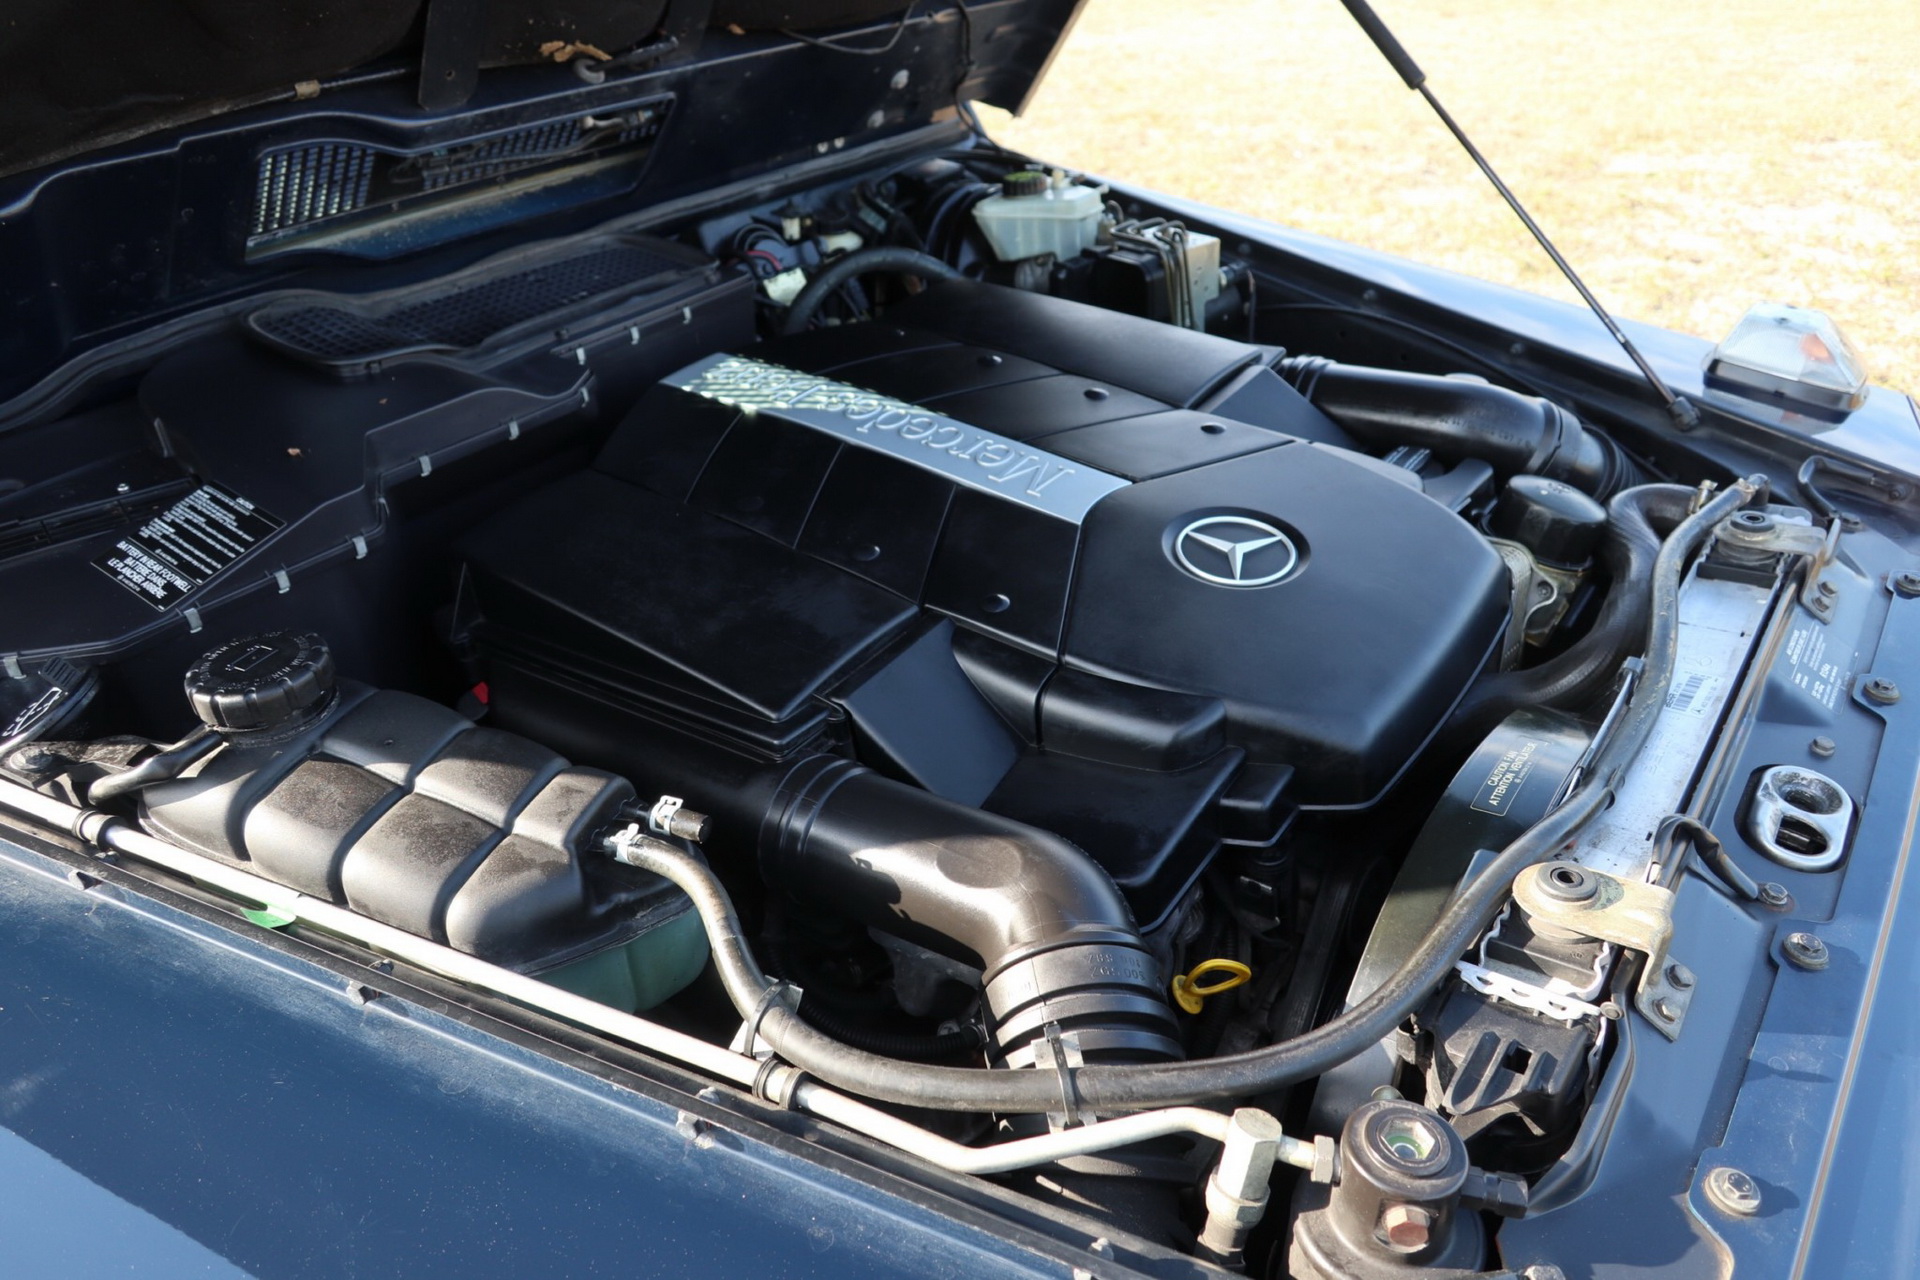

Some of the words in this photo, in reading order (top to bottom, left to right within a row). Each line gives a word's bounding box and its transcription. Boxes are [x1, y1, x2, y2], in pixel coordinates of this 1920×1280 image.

[115, 540, 143, 560] BATTERY
[139, 555, 149, 563] IN
[158, 567, 192, 592] FOOTWELL
[1487, 762, 1509, 786] CAUTION
[1504, 750, 1519, 762] FAN
[1488, 771, 1516, 806] ATTENTION
